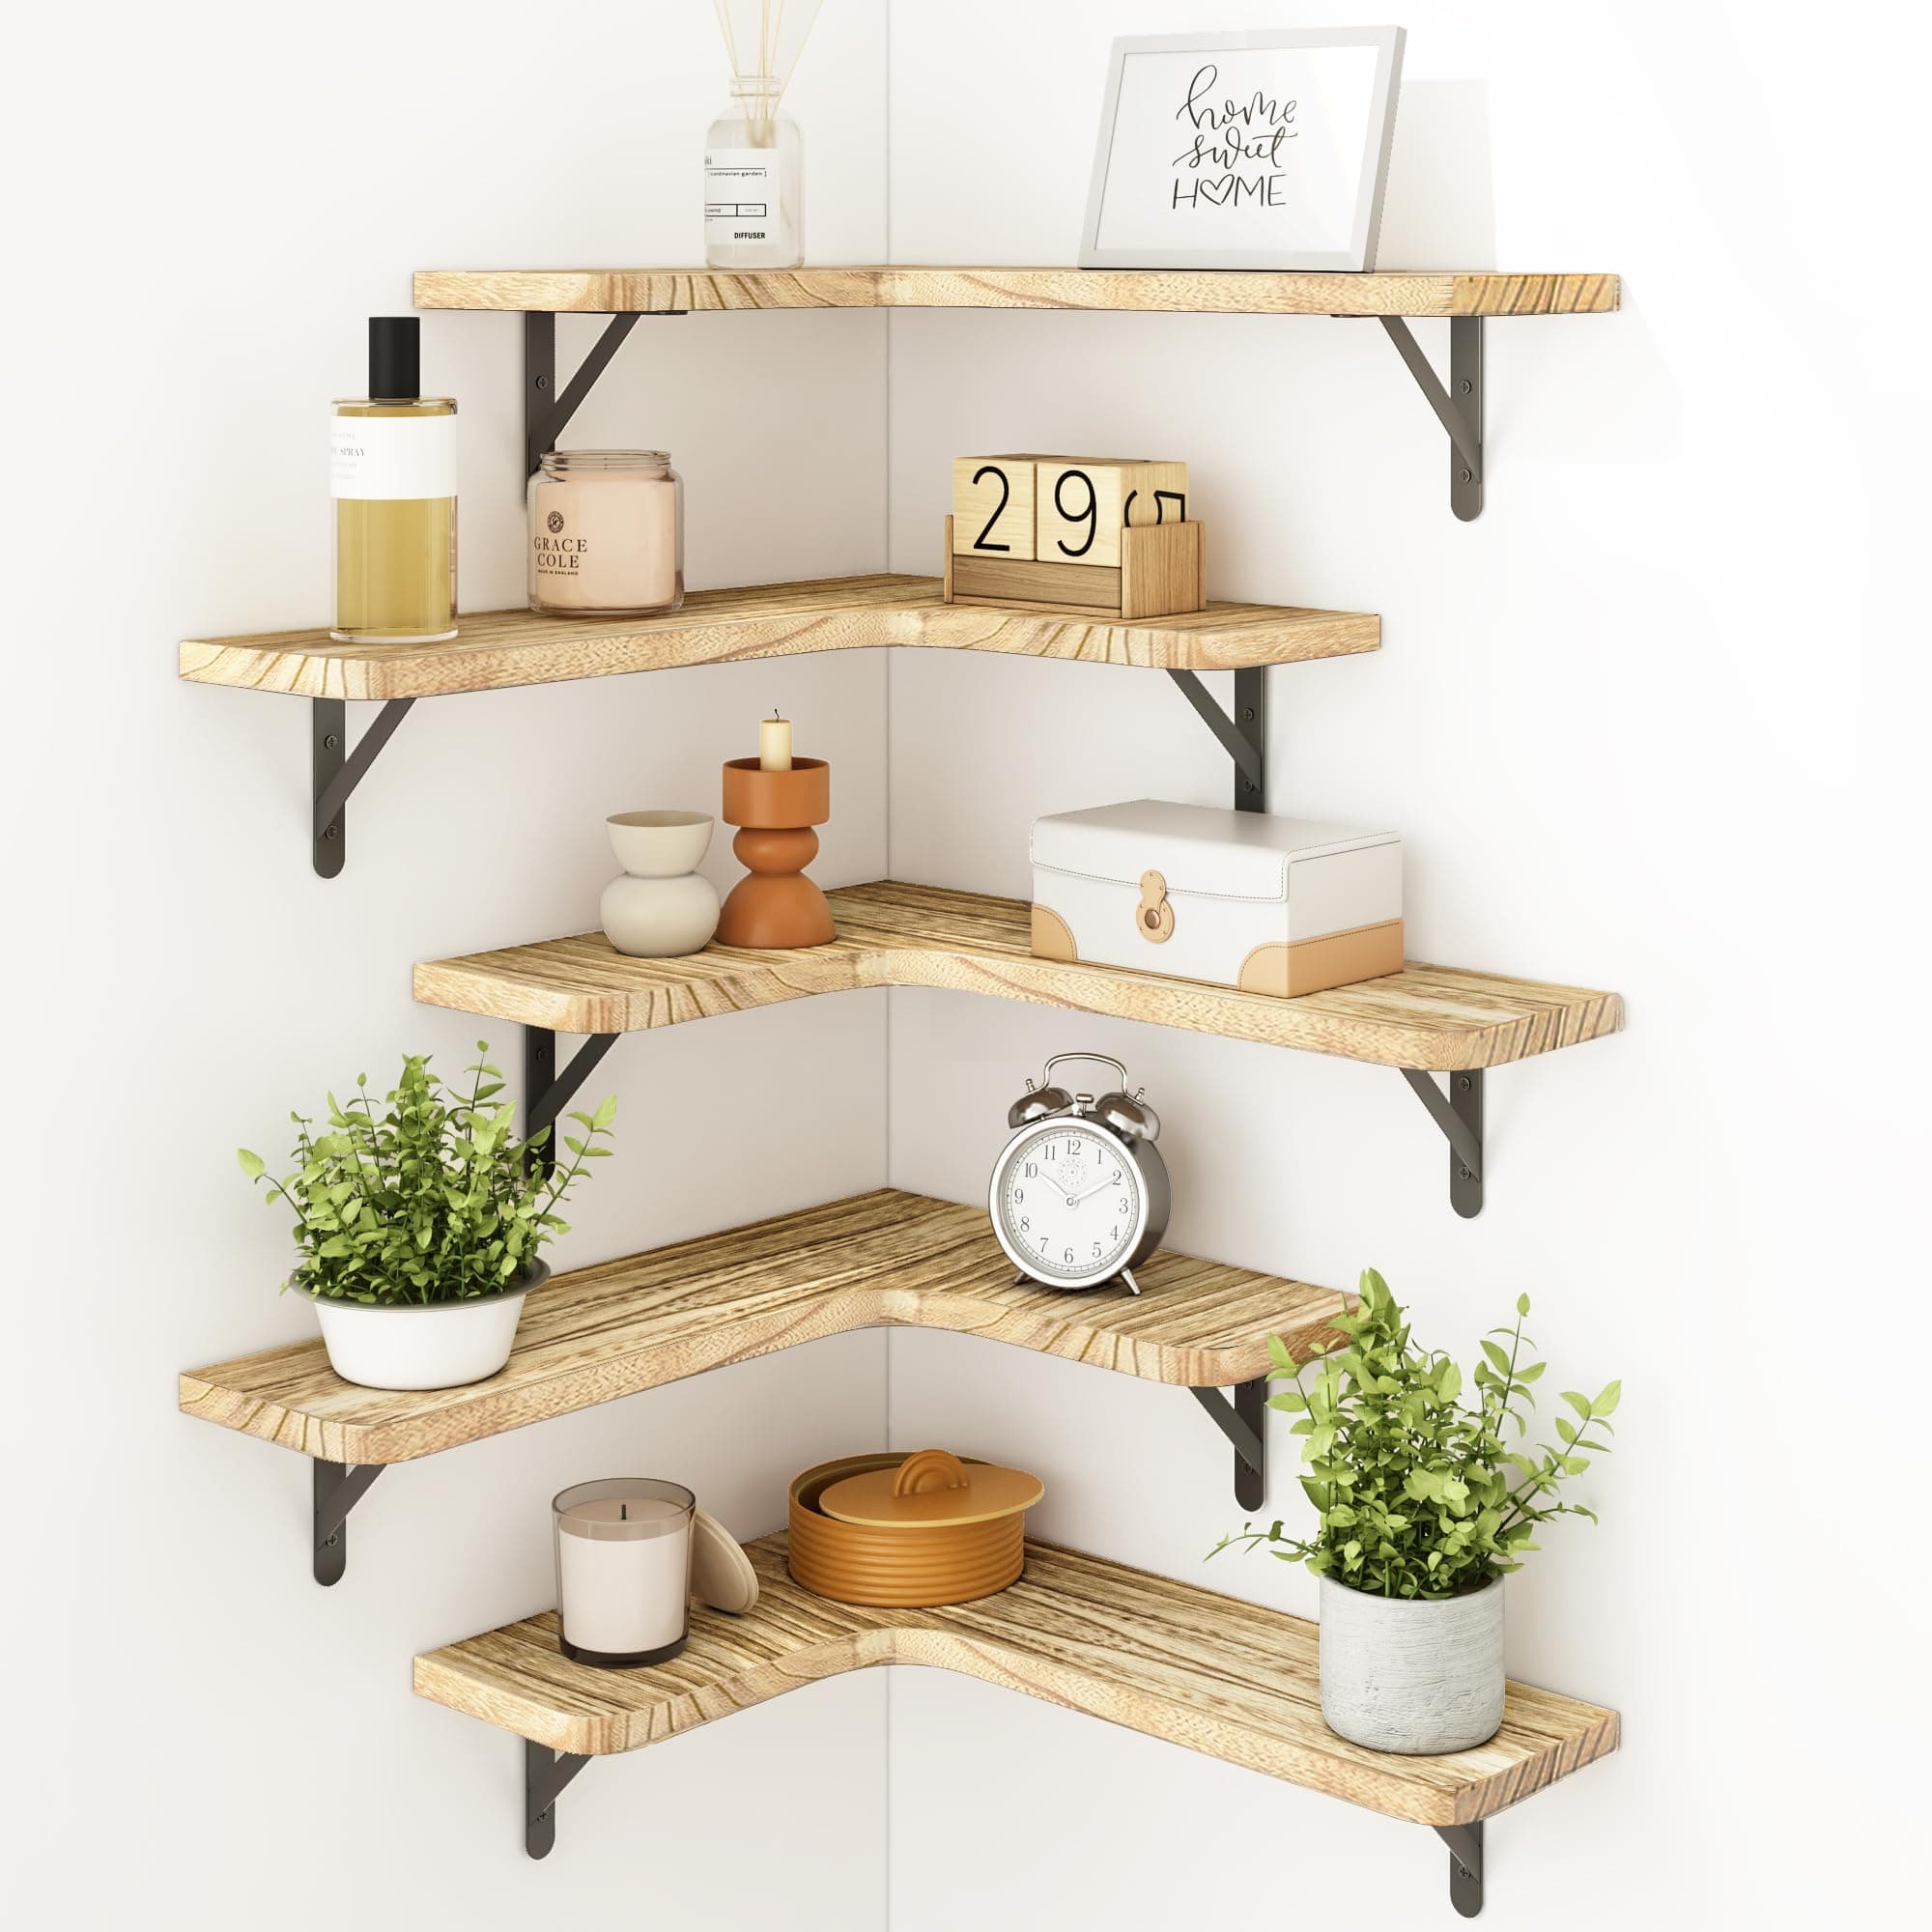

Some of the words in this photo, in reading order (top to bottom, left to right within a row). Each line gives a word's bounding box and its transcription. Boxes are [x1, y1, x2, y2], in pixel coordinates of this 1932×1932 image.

[1176, 64, 1297, 129] home
[1172, 126, 1298, 170] sweet
[339, 447, 365, 457] SPRAY
[534, 536, 587, 553] GRACE
[537, 553, 580, 569] COLE
[1045, 1145, 1056, 1160] 11
[1066, 1139, 1081, 1155] 12
[1025, 1162, 1038, 1179] 10
[1112, 1170, 1122, 1185] 2
[1014, 1188, 1024, 1205] 9
[1119, 1198, 1128, 1213] 3
[1020, 1216, 1030, 1232] 8
[1110, 1225, 1118, 1240] 4
[1039, 1237, 1049, 1253] 7
[1092, 1241, 1102, 1258] 5
[1065, 1247, 1074, 1264] 6
